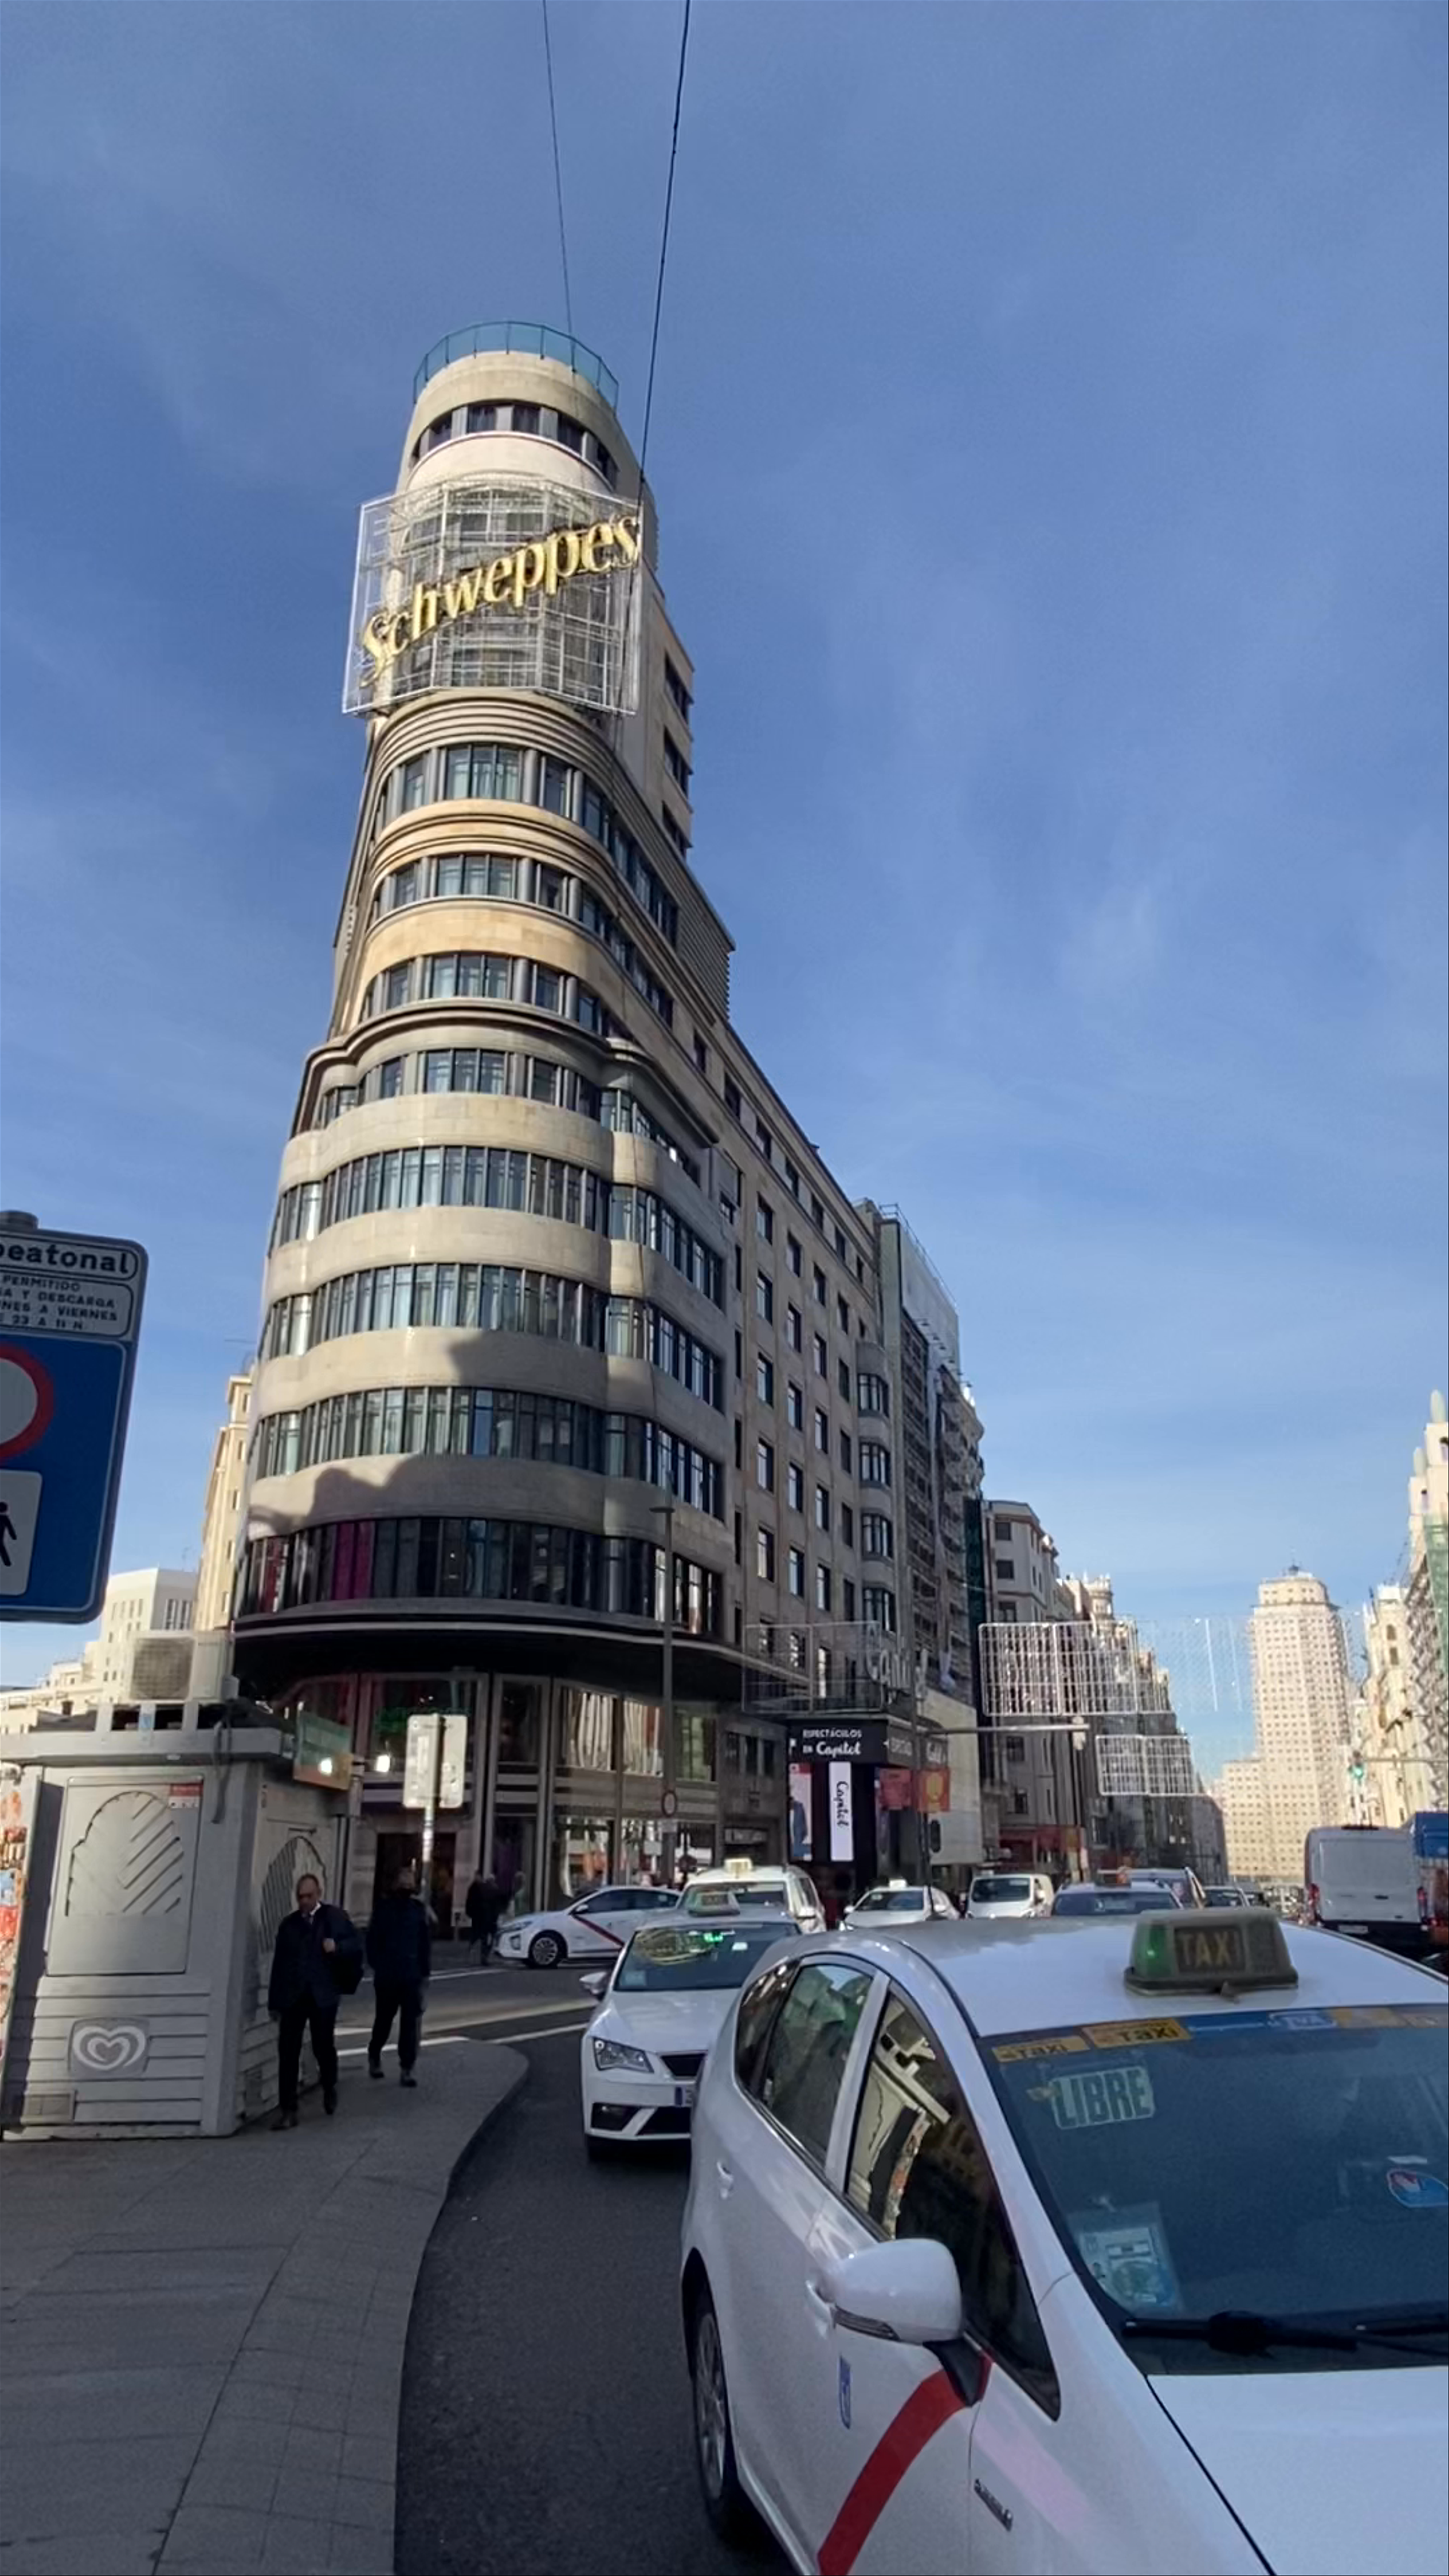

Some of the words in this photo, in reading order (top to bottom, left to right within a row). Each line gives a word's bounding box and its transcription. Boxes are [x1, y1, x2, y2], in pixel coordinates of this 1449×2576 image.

[360, 514, 641, 687] Schweppes
[0, 1243, 128, 1274] eatonal
[39, 1304, 48, 1314] A
[58, 1305, 117, 1321] VIERNES
[816, 1740, 861, 1759] Capitol
[834, 1780, 849, 1827] Capitol
[1178, 1931, 1241, 1967] TAXI
[1053, 2067, 1154, 2128] LIBRE
